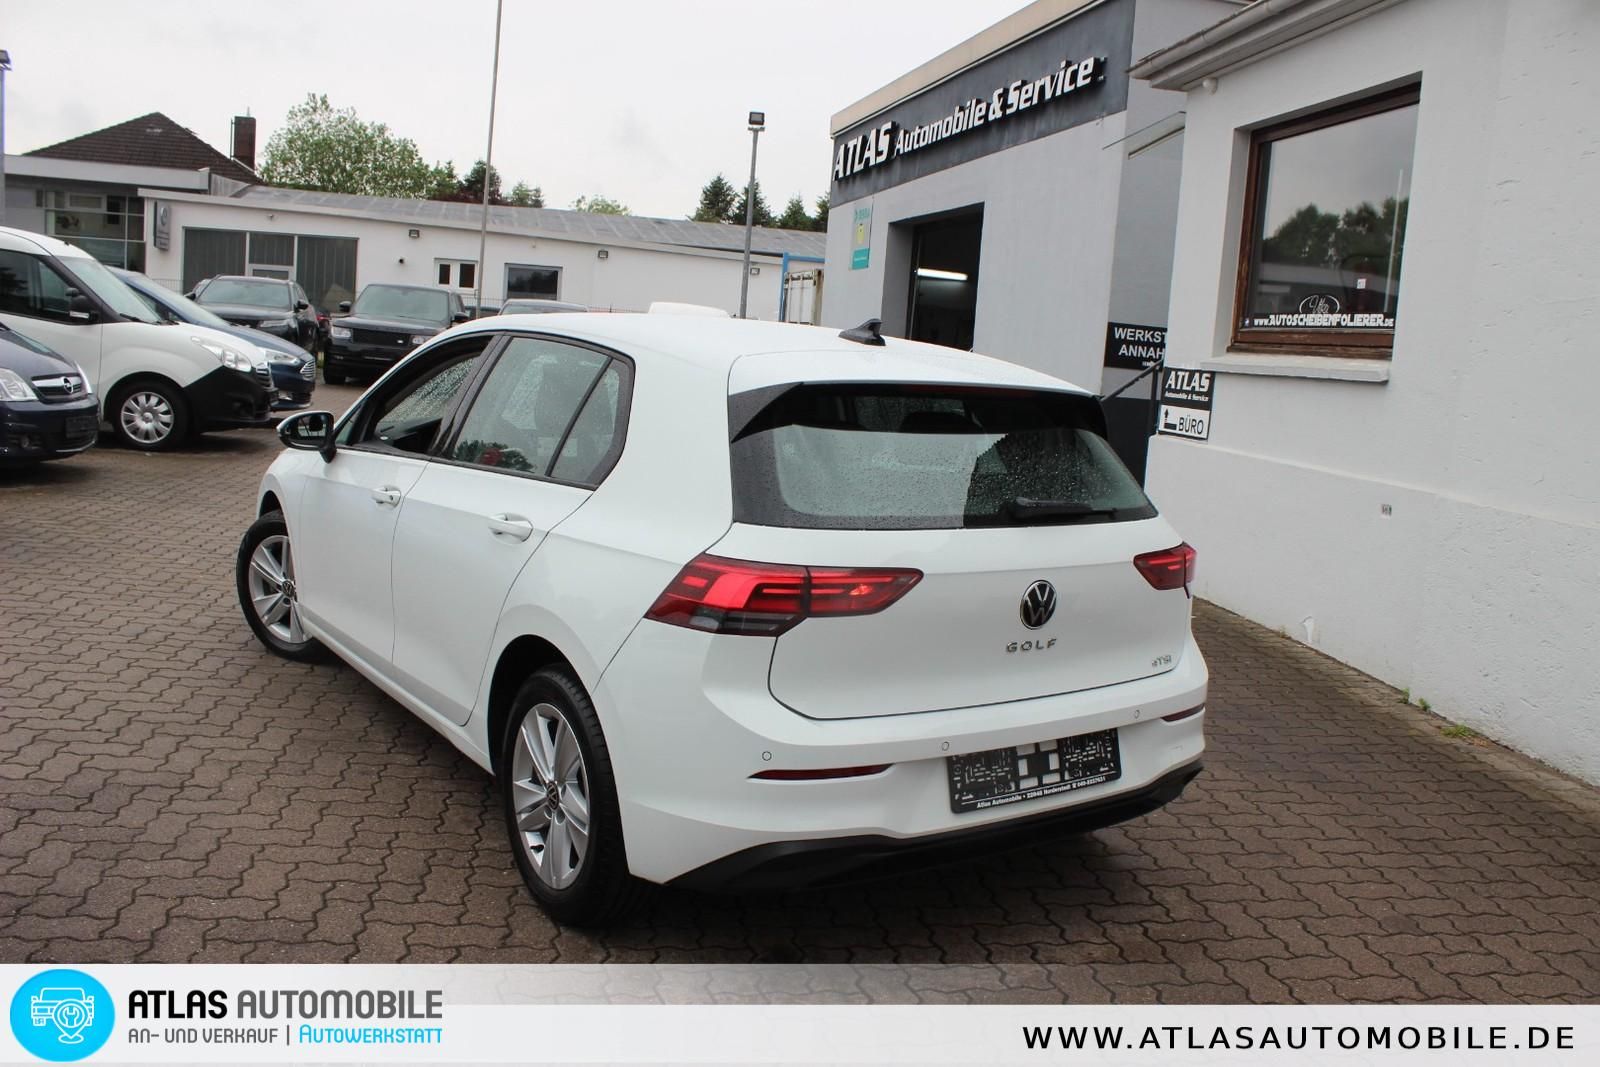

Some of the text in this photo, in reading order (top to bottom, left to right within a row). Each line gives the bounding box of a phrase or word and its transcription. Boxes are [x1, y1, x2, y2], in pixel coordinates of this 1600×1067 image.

[833, 57, 1095, 181] ATLAS Automobile & Service
[1165, 370, 1211, 392] ATLAS
[1178, 415, 1204, 435] BÜRO
[1006, 638, 1057, 653] GOLF
